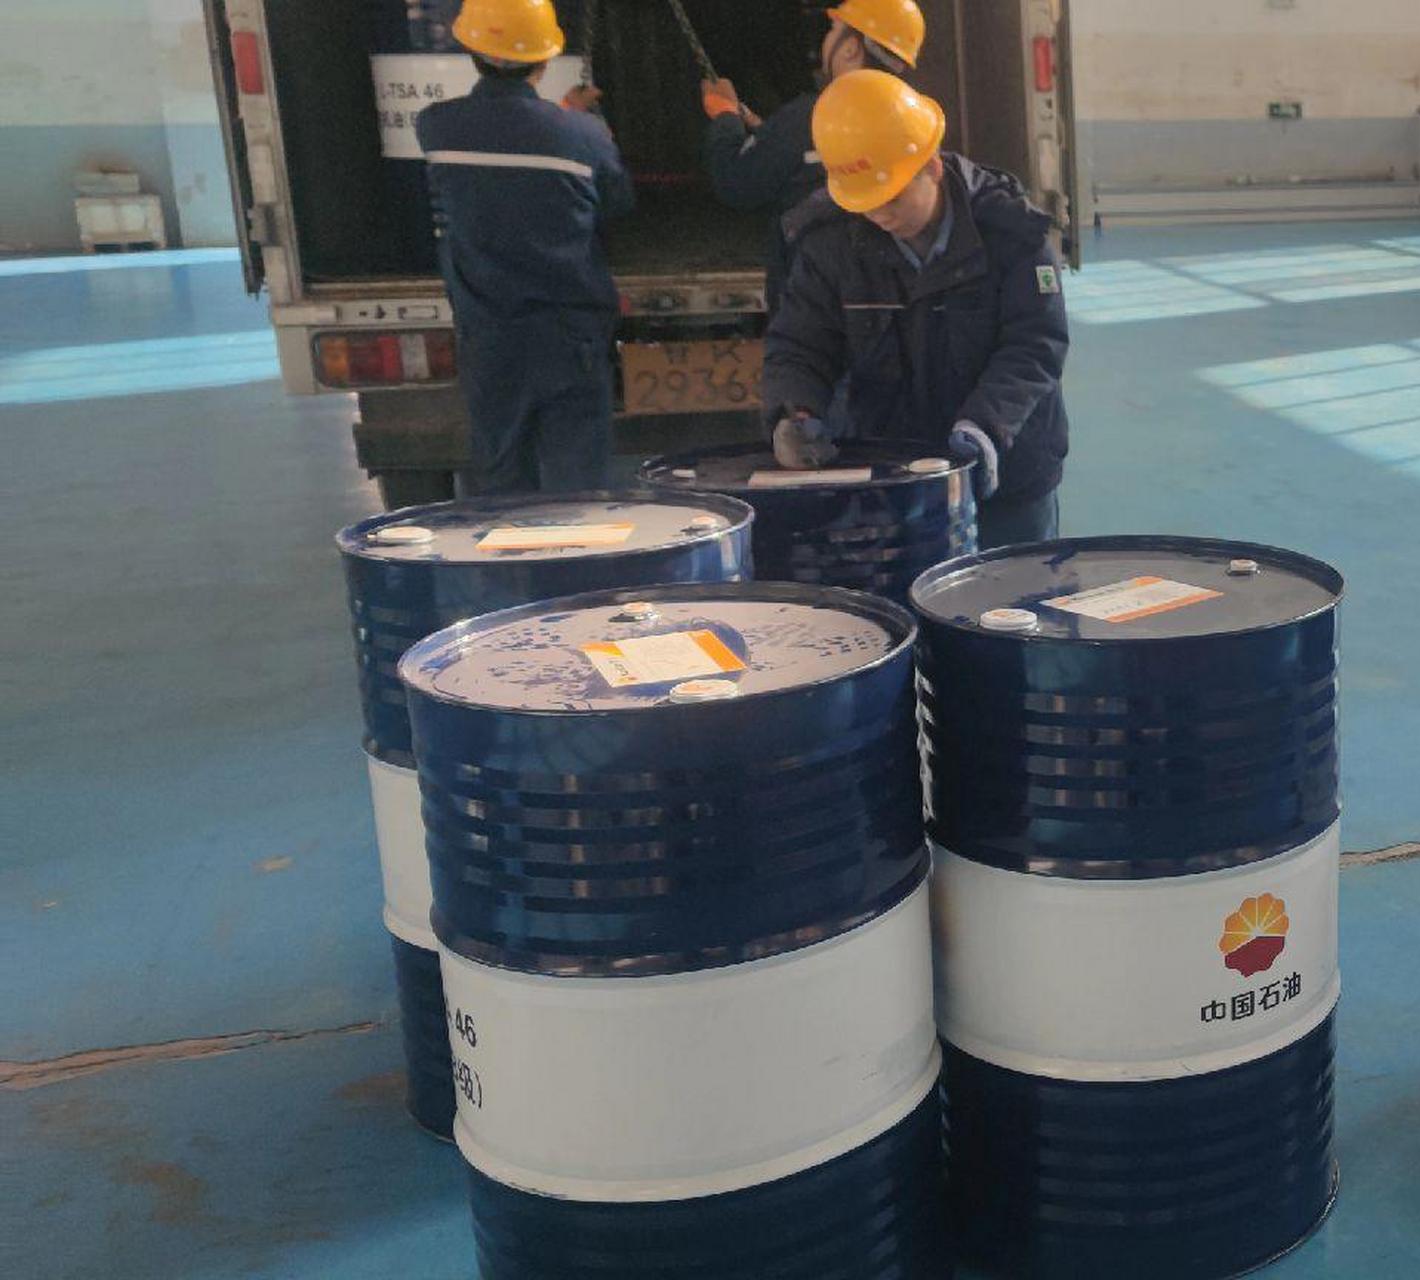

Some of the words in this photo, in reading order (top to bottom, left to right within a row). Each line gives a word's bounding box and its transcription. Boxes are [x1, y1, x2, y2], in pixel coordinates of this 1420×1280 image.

[1200, 971, 1301, 1022] 中国石油
[456, 1008, 477, 1047] 46
